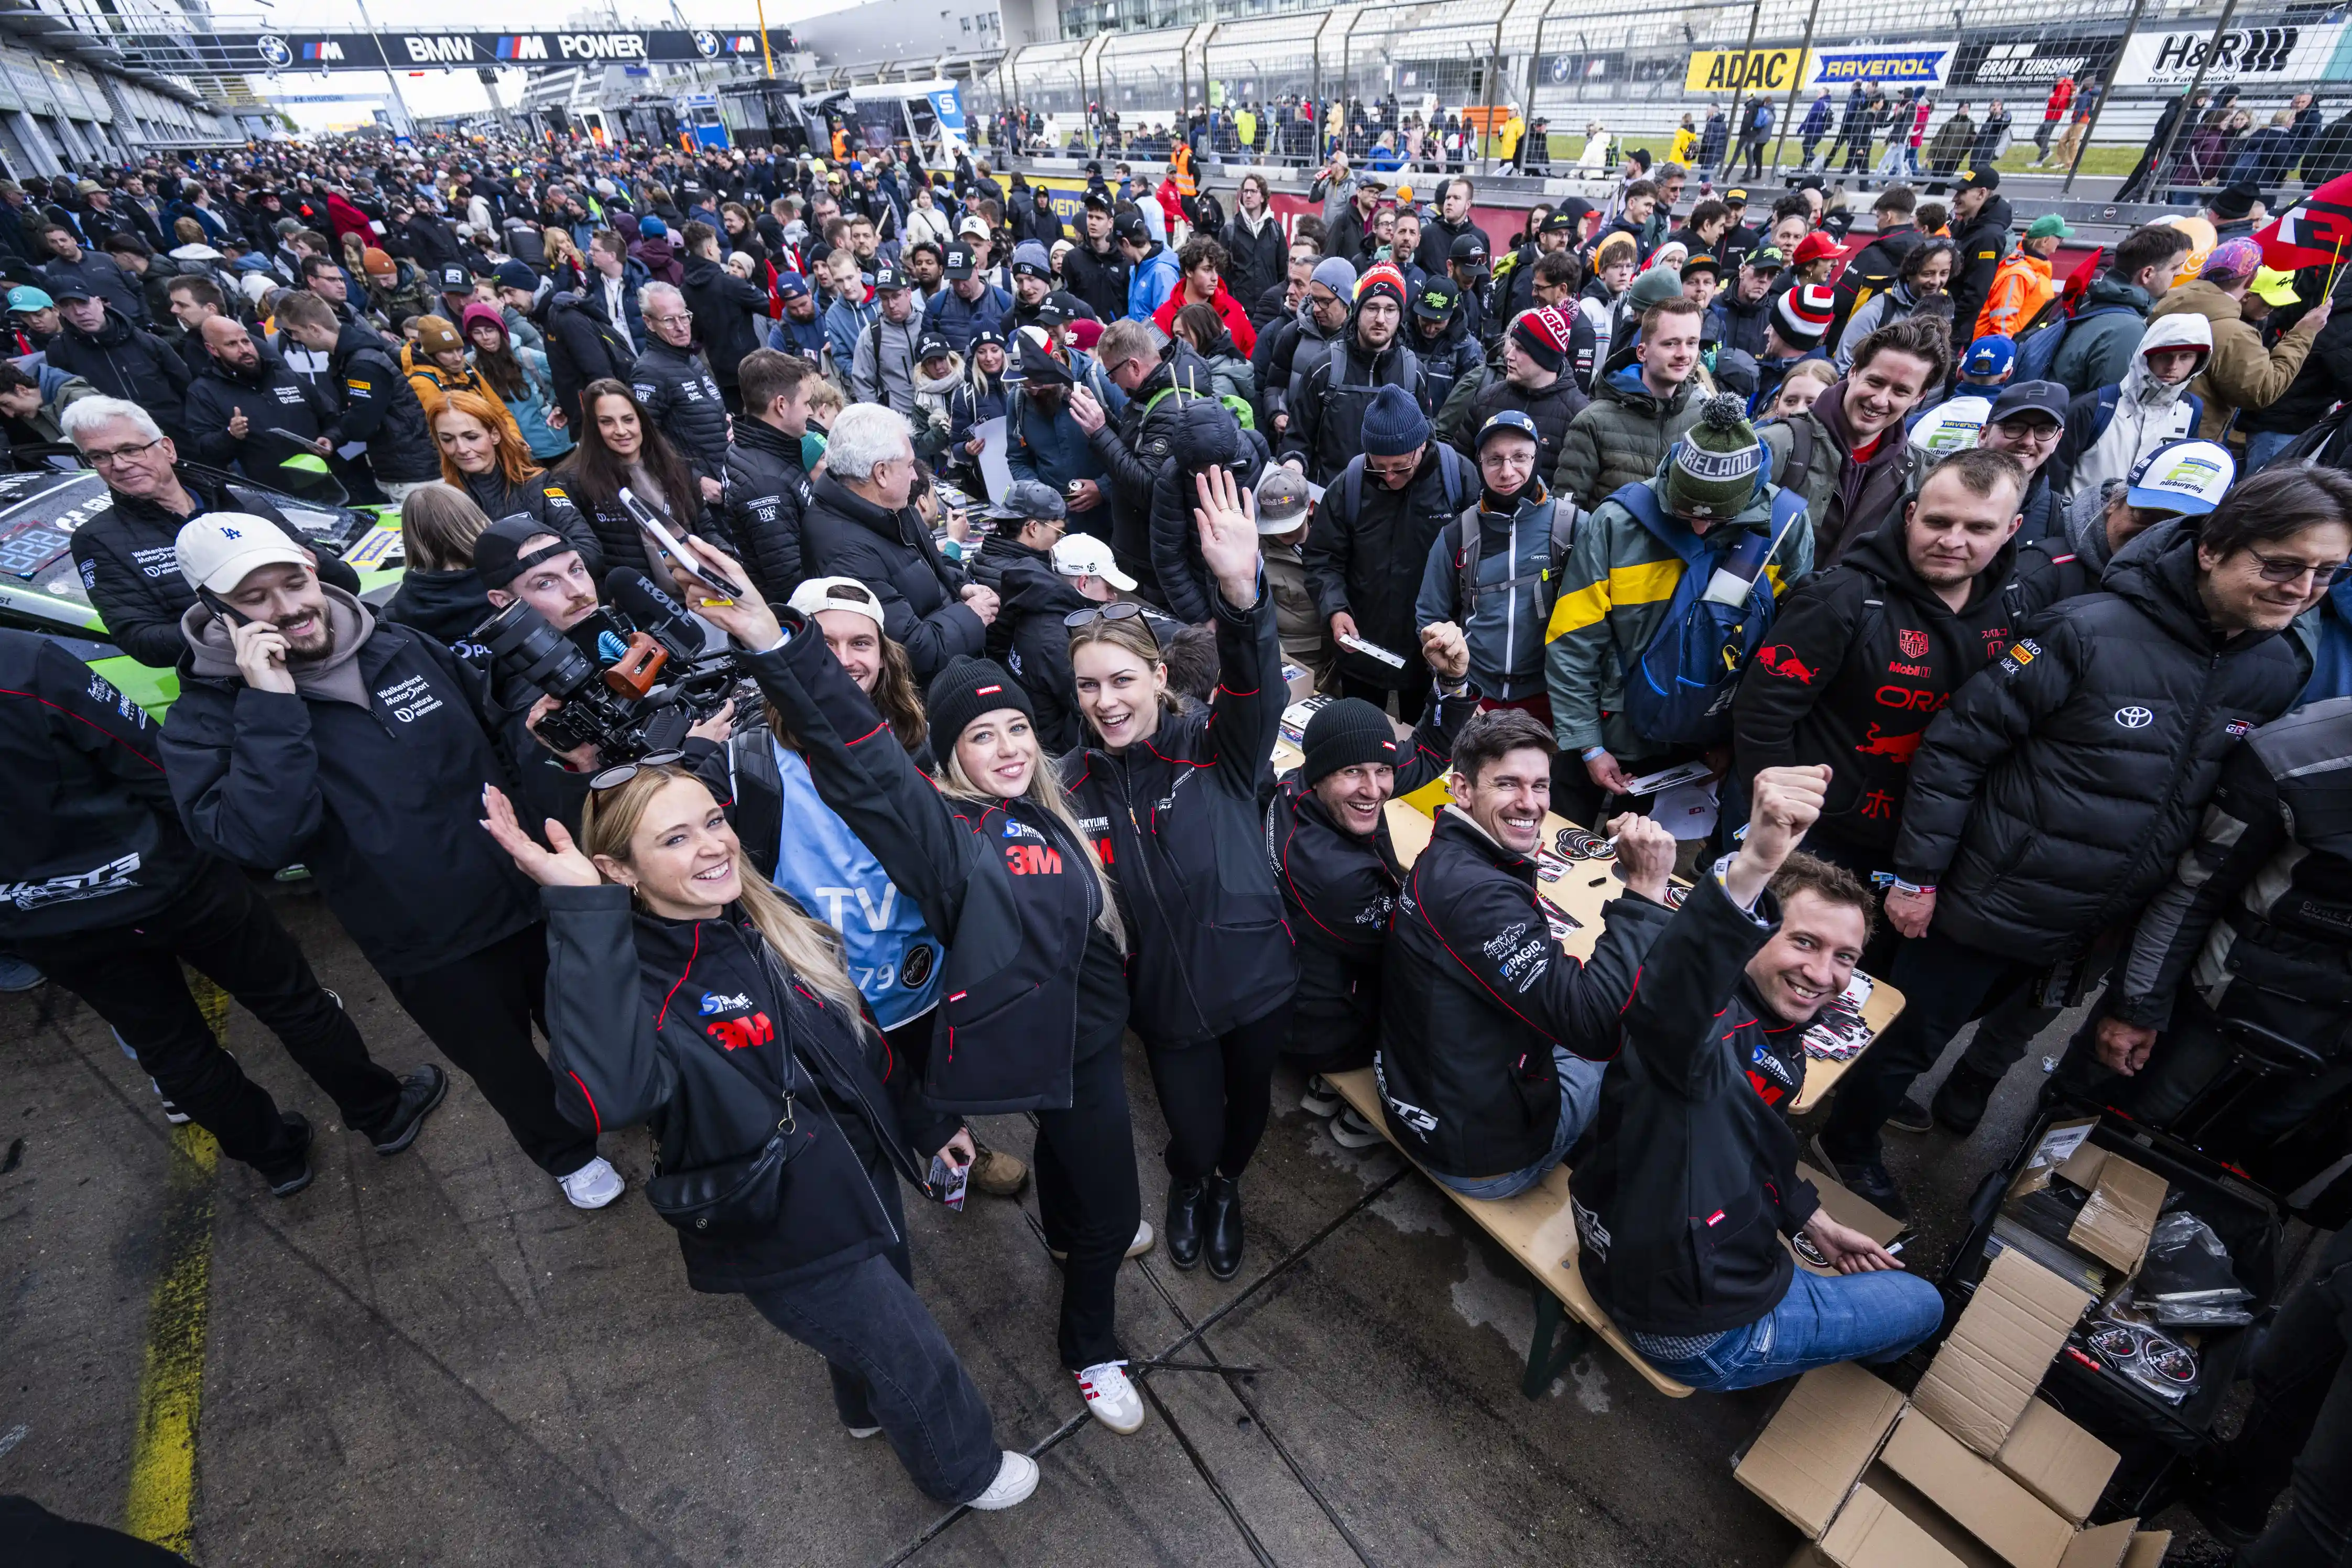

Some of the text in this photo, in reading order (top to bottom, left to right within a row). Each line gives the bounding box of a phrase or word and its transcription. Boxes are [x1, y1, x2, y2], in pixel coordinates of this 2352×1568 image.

[404, 37, 474, 61] BMW
[558, 35, 647, 58] POWER
[2154, 34, 2244, 70] H&R
[1705, 52, 1788, 89] ADAC
[1827, 57, 1932, 78] RAVENOL
[1977, 57, 2085, 77] GRAN TURISMO
[2006, 74, 2032, 83] DRIVING
[1681, 446, 1751, 476] IRELAND
[2159, 480, 2203, 494] nürburgring
[751, 497, 776, 507] RAVENOL
[757, 506, 776, 520] BAF
[220, 527, 243, 540] LA
[637, 575, 693, 627] RØDE
[1902, 631, 1928, 644] TAG
[2020, 637, 2042, 656] KINTO
[1900, 642, 1928, 656] HEUER
[1888, 661, 1930, 677] Mobil 1
[377, 674, 423, 699] Walkenhorst
[384, 681, 430, 706] MotorSport
[978, 686, 1000, 694] MOTUL
[410, 694, 433, 710] natural
[416, 700, 443, 716] elements
[1875, 685, 1950, 713] ORA
[2227, 724, 2247, 735] GR
[1079, 816, 1108, 830] SKYLINE
[1006, 845, 1062, 875] 3M
[815, 882, 897, 934] TV
[1485, 930, 1520, 959] HEIMAT
[1507, 940, 1541, 970] PAGID
[1508, 946, 1546, 983] RACING
[1520, 963, 1548, 993] WALKENHORST
[950, 993, 967, 1002] MOTUL
[706, 1010, 775, 1051] 3M
[1708, 1213, 1725, 1226] MOTUL
